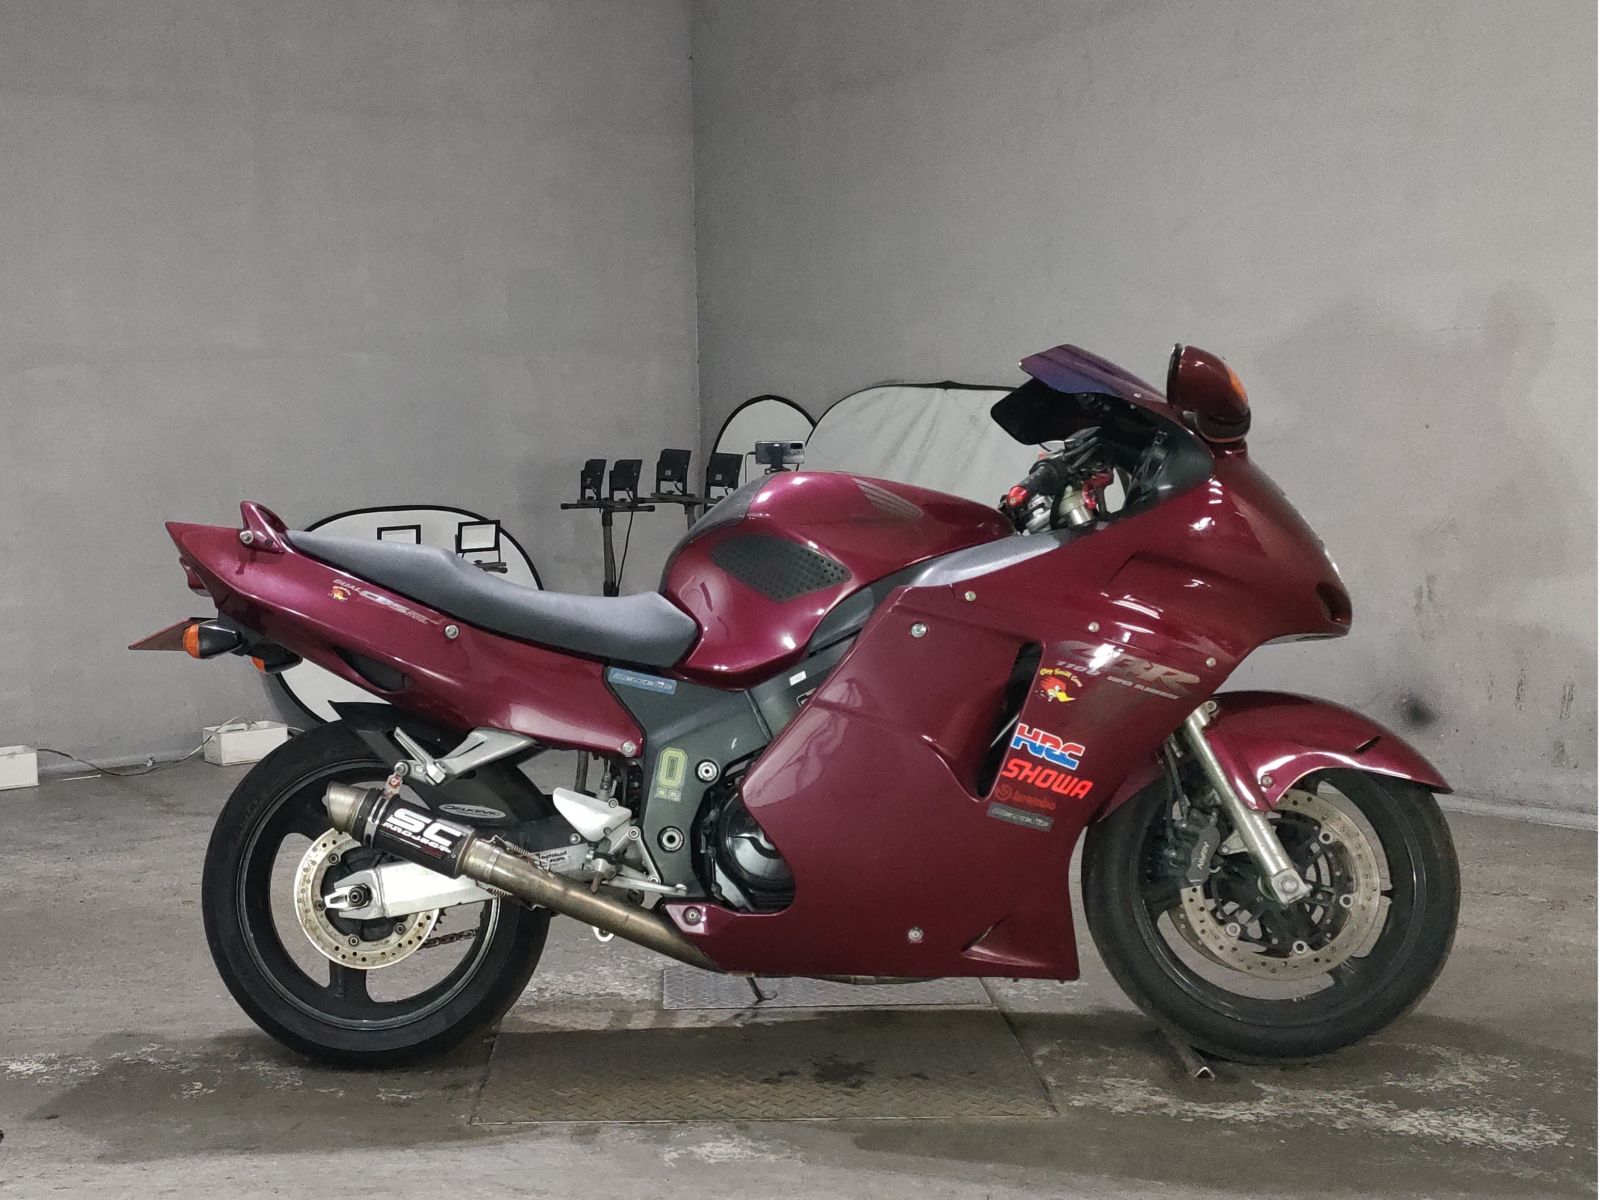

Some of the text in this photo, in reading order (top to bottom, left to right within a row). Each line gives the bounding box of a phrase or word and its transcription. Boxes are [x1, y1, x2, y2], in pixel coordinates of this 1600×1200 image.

[1010, 722, 1086, 771] HRC
[1001, 758, 1093, 799] SHOWA
[380, 821, 452, 854] PROJECT
[386, 807, 463, 848] SC
